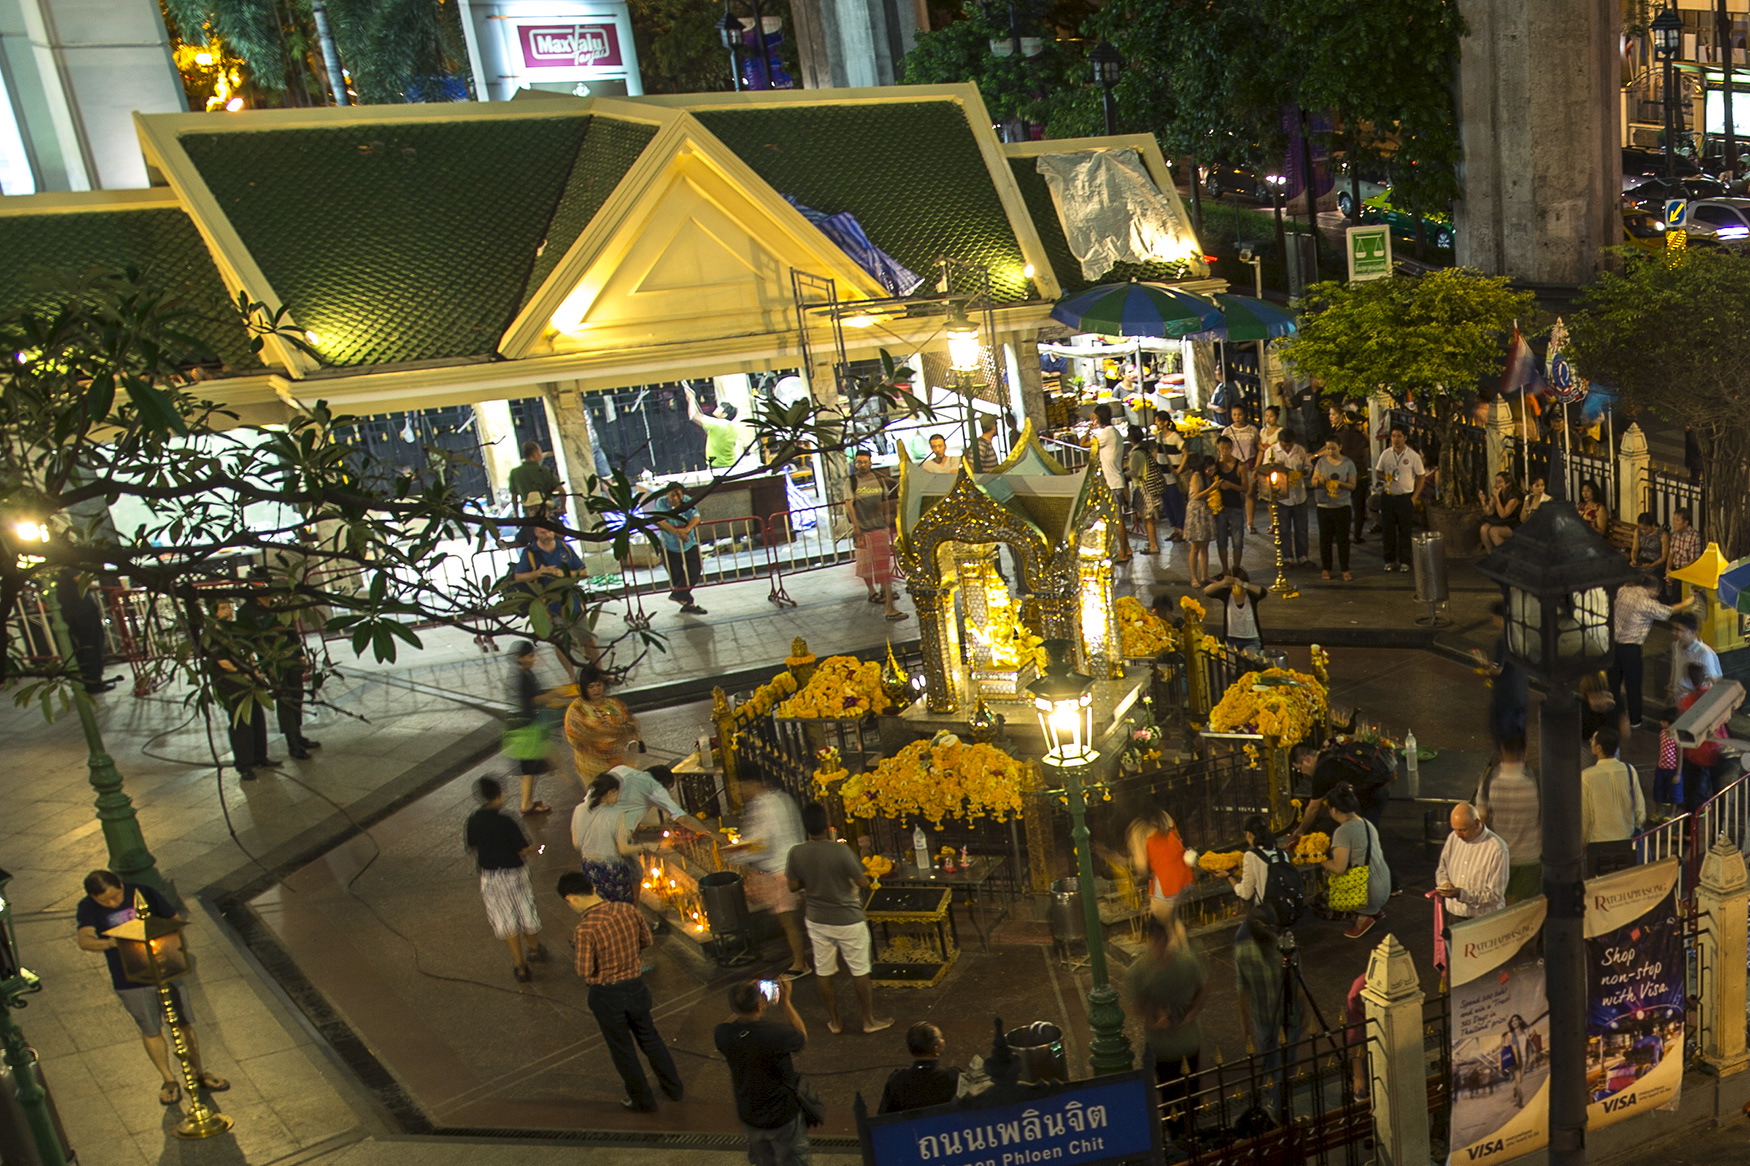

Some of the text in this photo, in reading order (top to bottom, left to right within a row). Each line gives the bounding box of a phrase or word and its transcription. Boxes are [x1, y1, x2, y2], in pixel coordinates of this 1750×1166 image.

[536, 25, 602, 53] MaxValu
[1601, 946, 1635, 966] Shop
[1600, 960, 1662, 986] non-stop
[1601, 986, 1637, 1007] with
[1601, 1093, 1637, 1113] VISA
[918, 1100, 1108, 1161] ถนนเพลินจิต
[1068, 1136, 1105, 1155] Chit
[1466, 1139, 1504, 1160] VISA
